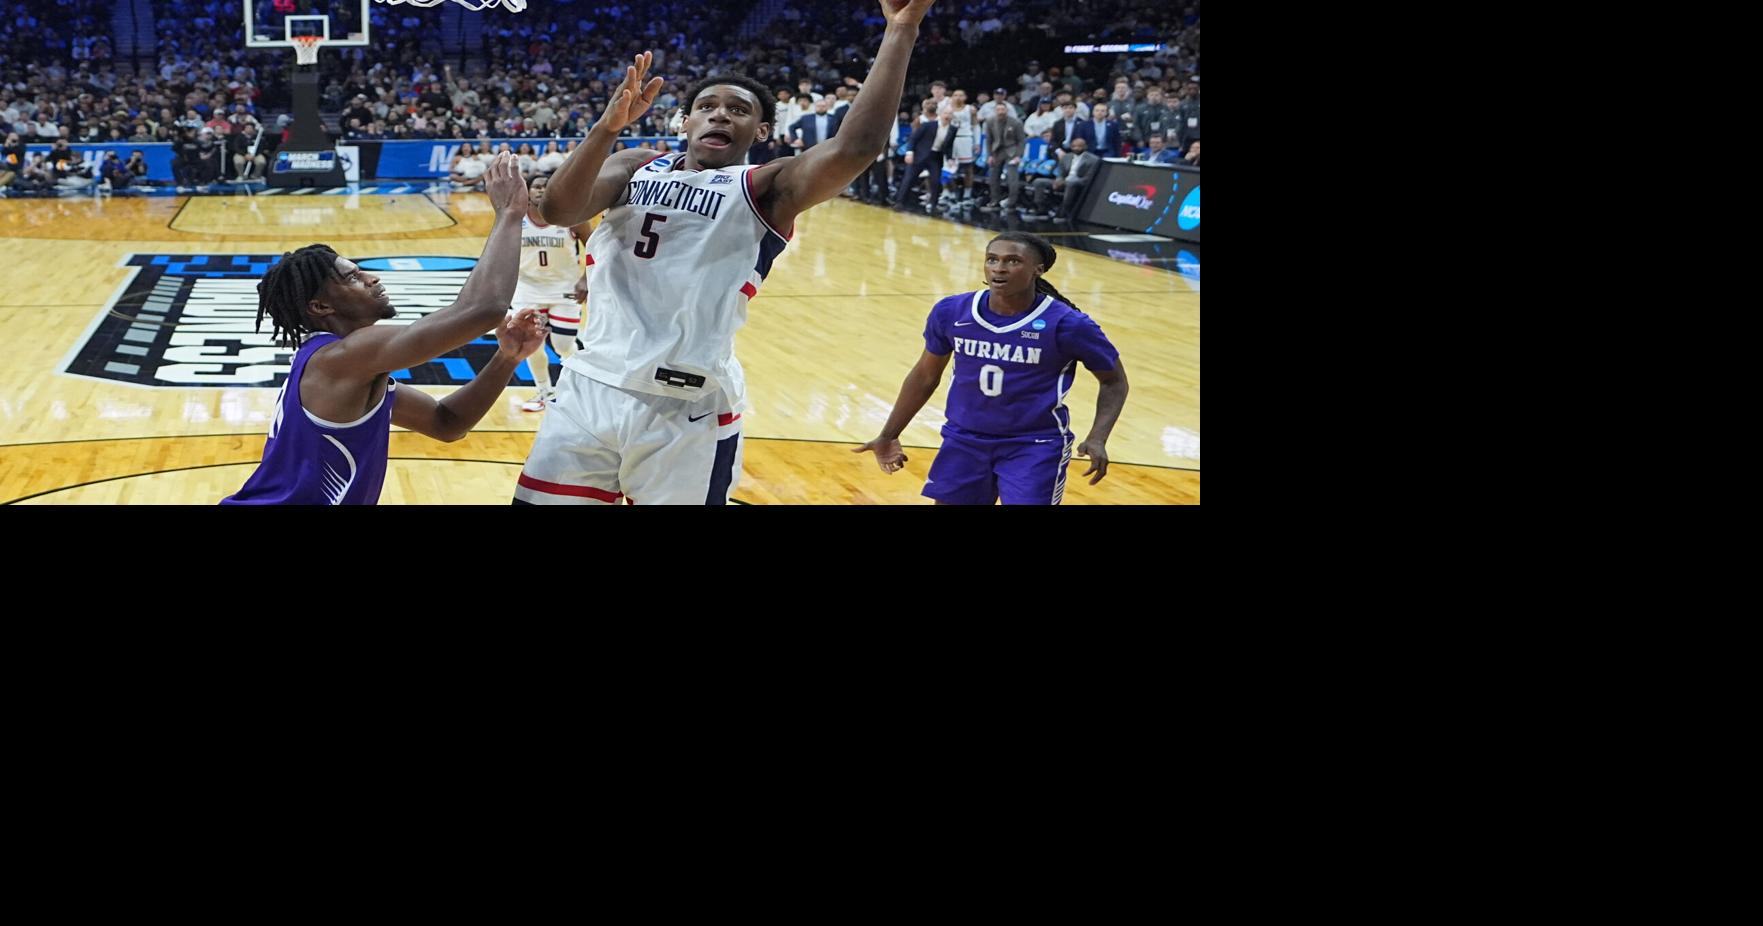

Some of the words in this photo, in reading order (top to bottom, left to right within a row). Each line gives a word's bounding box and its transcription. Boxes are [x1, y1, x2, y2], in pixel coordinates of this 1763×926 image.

[288, 153, 319, 161] MARCH
[291, 160, 334, 169] MADNESS
[633, 212, 667, 259] 5
[539, 251, 548, 267] 0
[954, 337, 1042, 364] FURMAN
[979, 364, 1004, 397] 0
